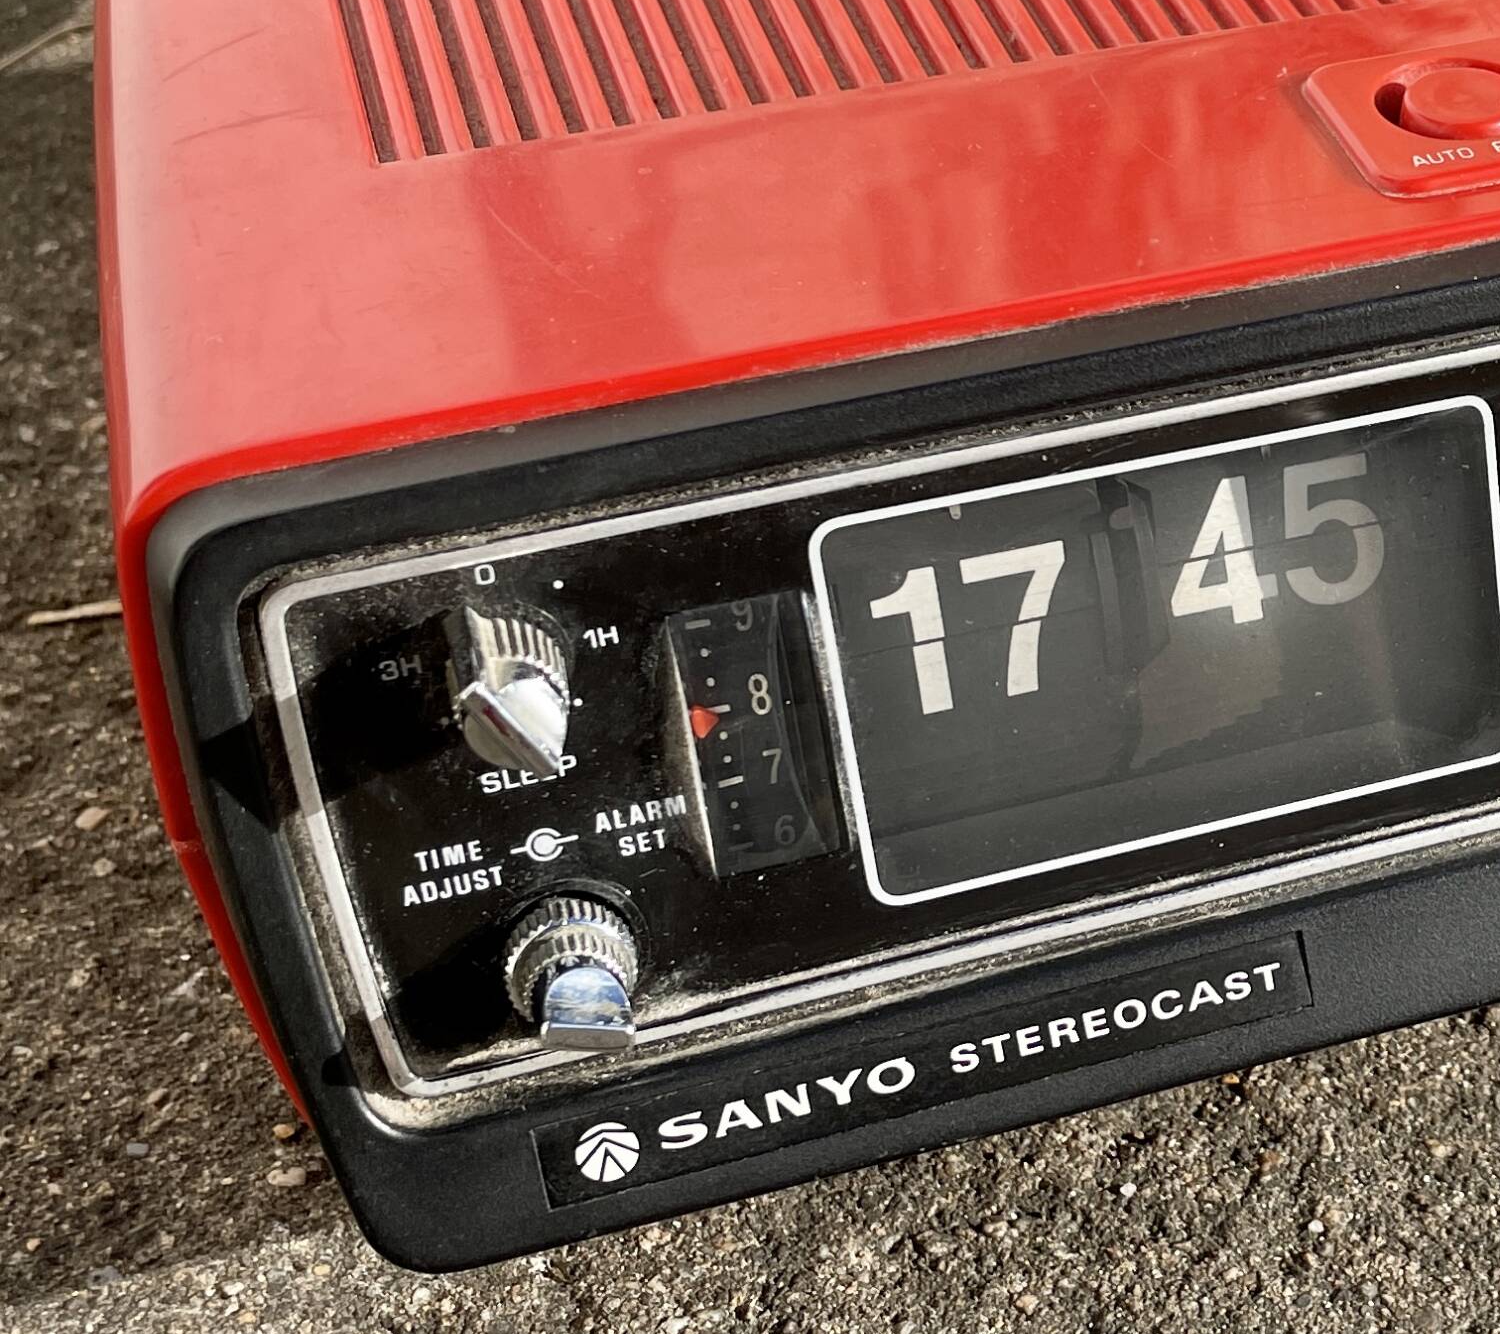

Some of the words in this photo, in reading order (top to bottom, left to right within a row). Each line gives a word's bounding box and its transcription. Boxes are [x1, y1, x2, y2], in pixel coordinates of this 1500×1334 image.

[1412, 146, 1475, 168] AUTO
[869, 540, 1066, 715] 17
[1170, 452, 1385, 624] 45
[583, 625, 620, 649] 1H
[378, 655, 423, 681] 3H
[748, 673, 772, 715] 8
[480, 755, 577, 794] SLEP
[762, 748, 782, 784] 7
[595, 794, 687, 833] ALARM
[774, 815, 796, 845] 6
[415, 840, 483, 872] TIME
[618, 828, 667, 857] SET
[403, 866, 503, 906] ADJUST
[657, 1056, 915, 1151] SANYO
[951, 961, 1283, 1075] STEREOCAST
